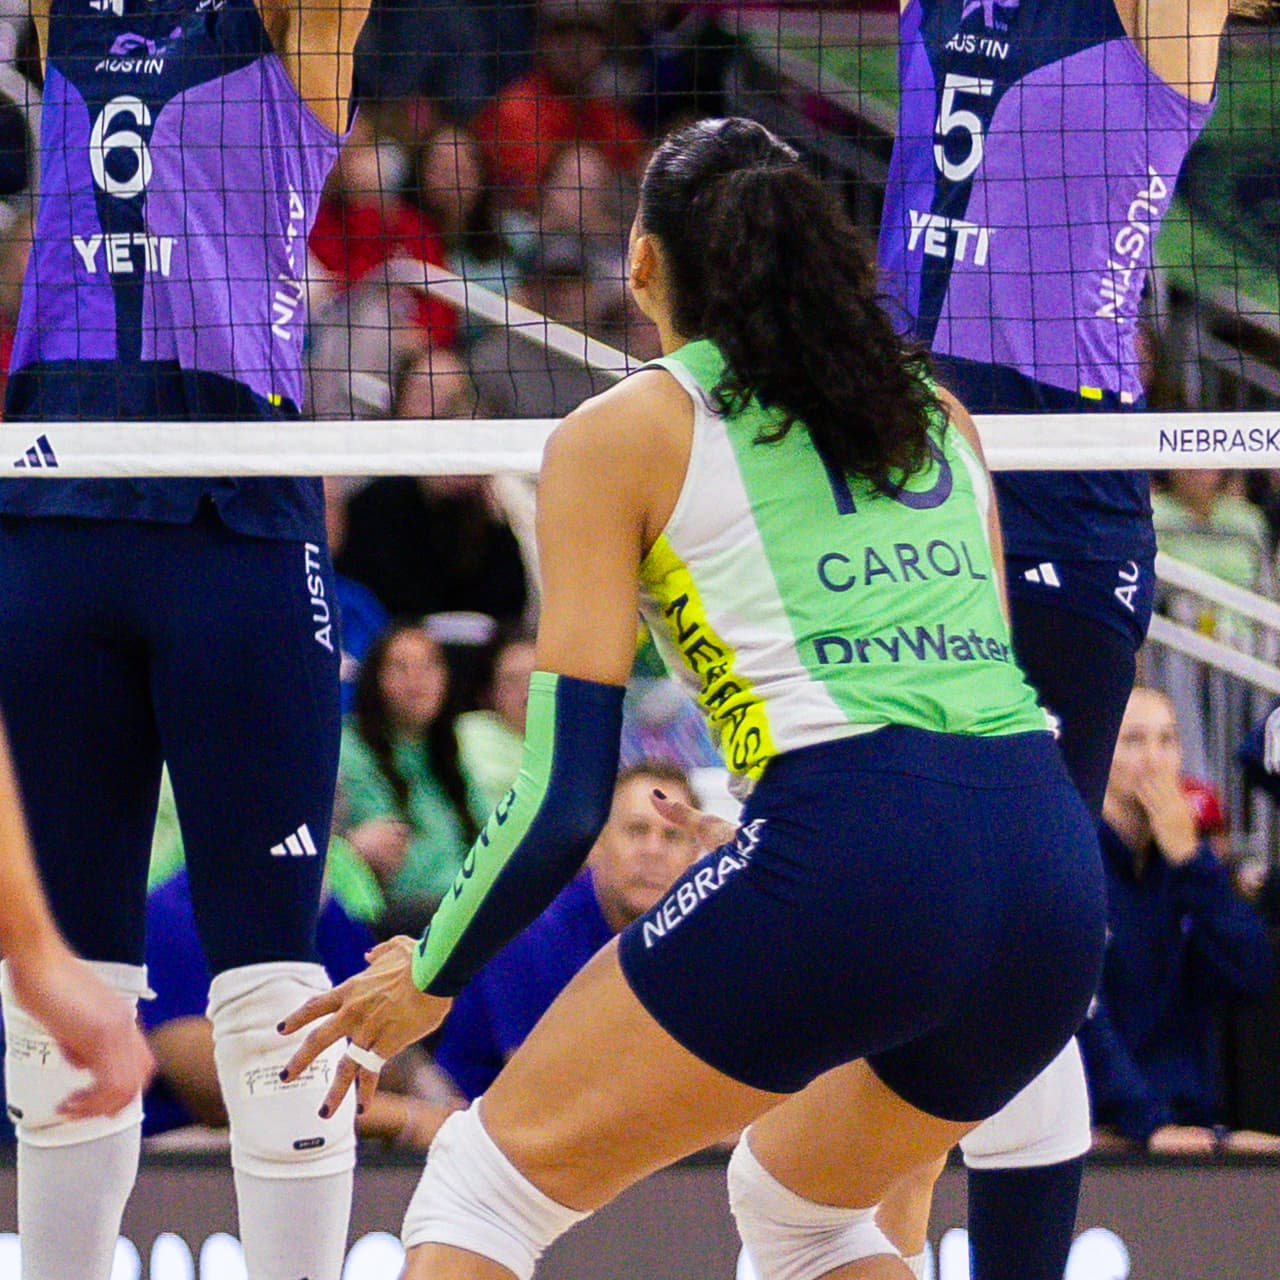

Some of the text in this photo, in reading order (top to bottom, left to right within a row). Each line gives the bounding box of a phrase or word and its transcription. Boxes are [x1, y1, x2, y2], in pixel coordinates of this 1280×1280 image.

[90, 95, 152, 200] 6
[933, 72, 994, 182] 5
[72, 233, 173, 277] YETI
[907, 209, 989, 267] YETI
[1096, 165, 1168, 325] AUSTIN
[1159, 428, 1280, 453] NEBRASK
[817, 539, 988, 593] CAROL
